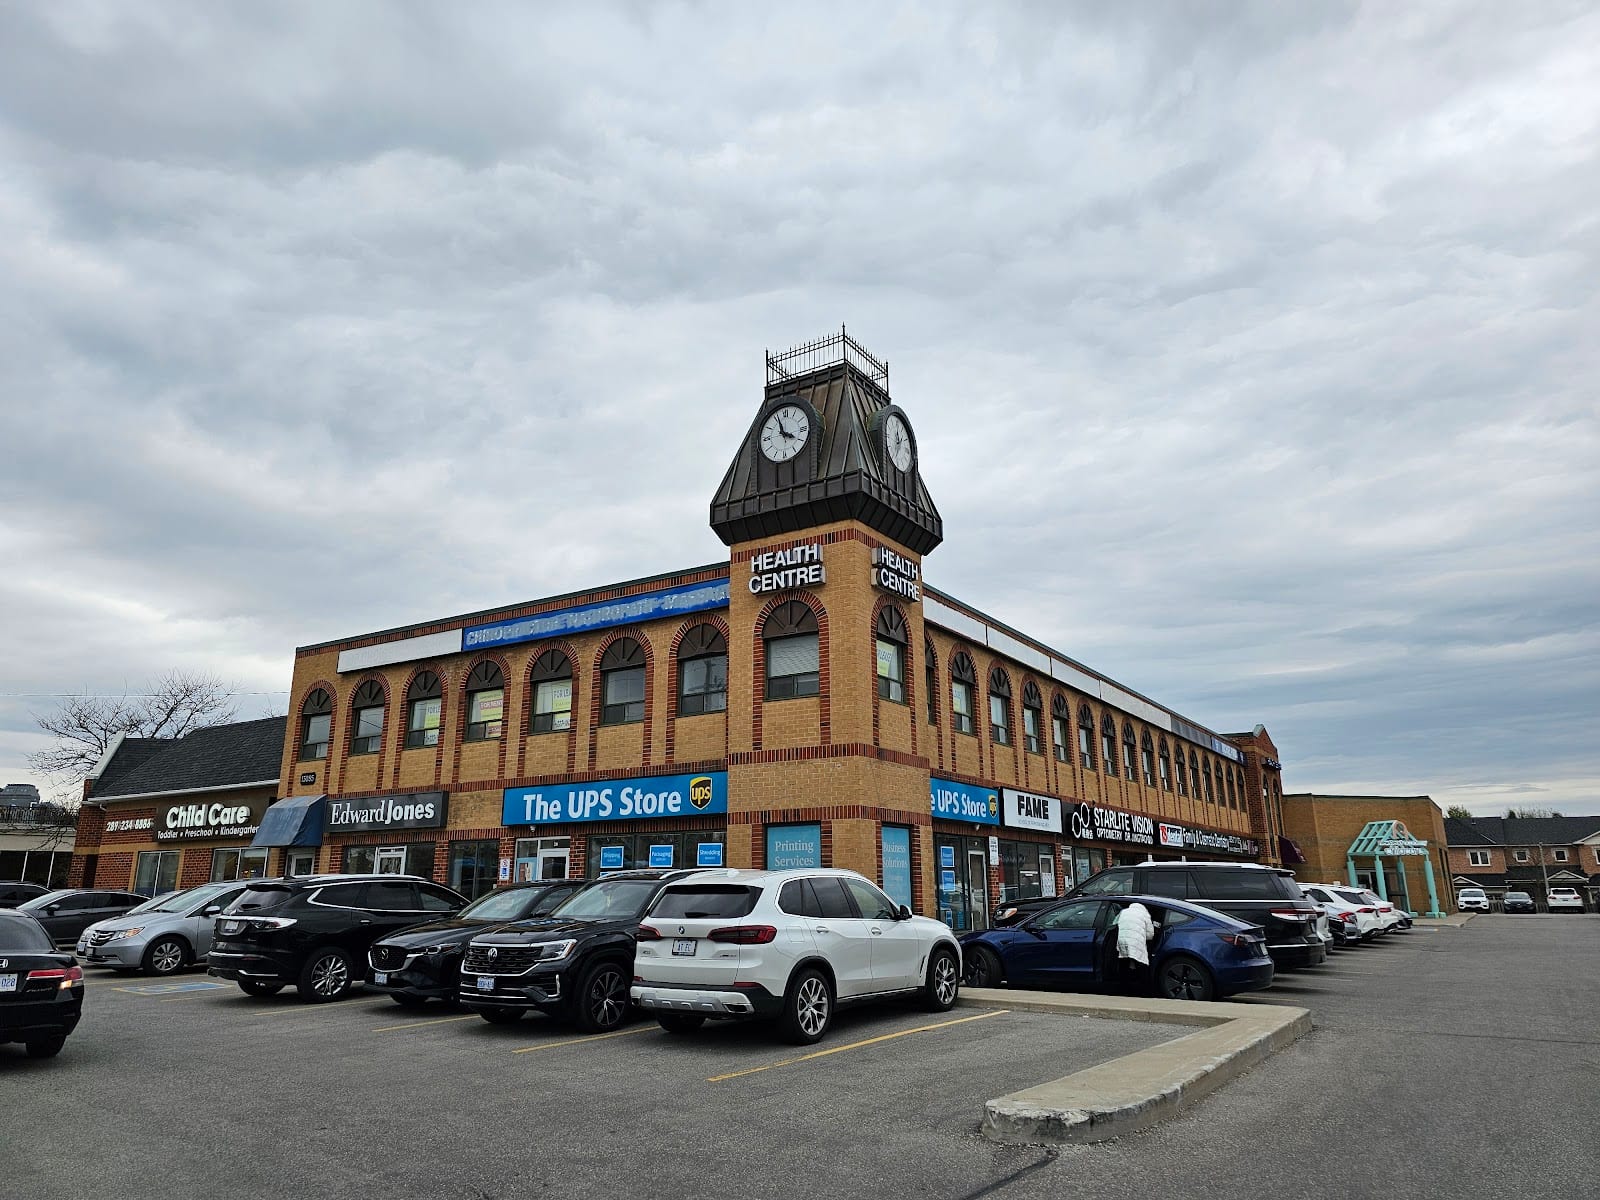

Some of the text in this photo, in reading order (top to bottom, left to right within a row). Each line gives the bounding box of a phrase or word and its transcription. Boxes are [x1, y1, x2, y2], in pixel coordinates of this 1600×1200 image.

[751, 543, 818, 573] HEALTH
[881, 546, 919, 581] HEALTH
[748, 564, 821, 594] CENTRE
[880, 568, 921, 602] CENTRE
[166, 802, 250, 829] Child Care
[523, 787, 682, 821] The UPS Store
[937, 788, 960, 815] UPS
[961, 793, 987, 818] Store
[1017, 794, 1049, 820] FAME
[157, 830, 178, 840] Toddler
[185, 828, 214, 838] Preschool
[1093, 807, 1131, 831] STARLITE
[1131, 814, 1154, 835] VISION
[699, 849, 721, 857] Shredding
[774, 855, 815, 867] Services
[775, 840, 814, 854] Printing
